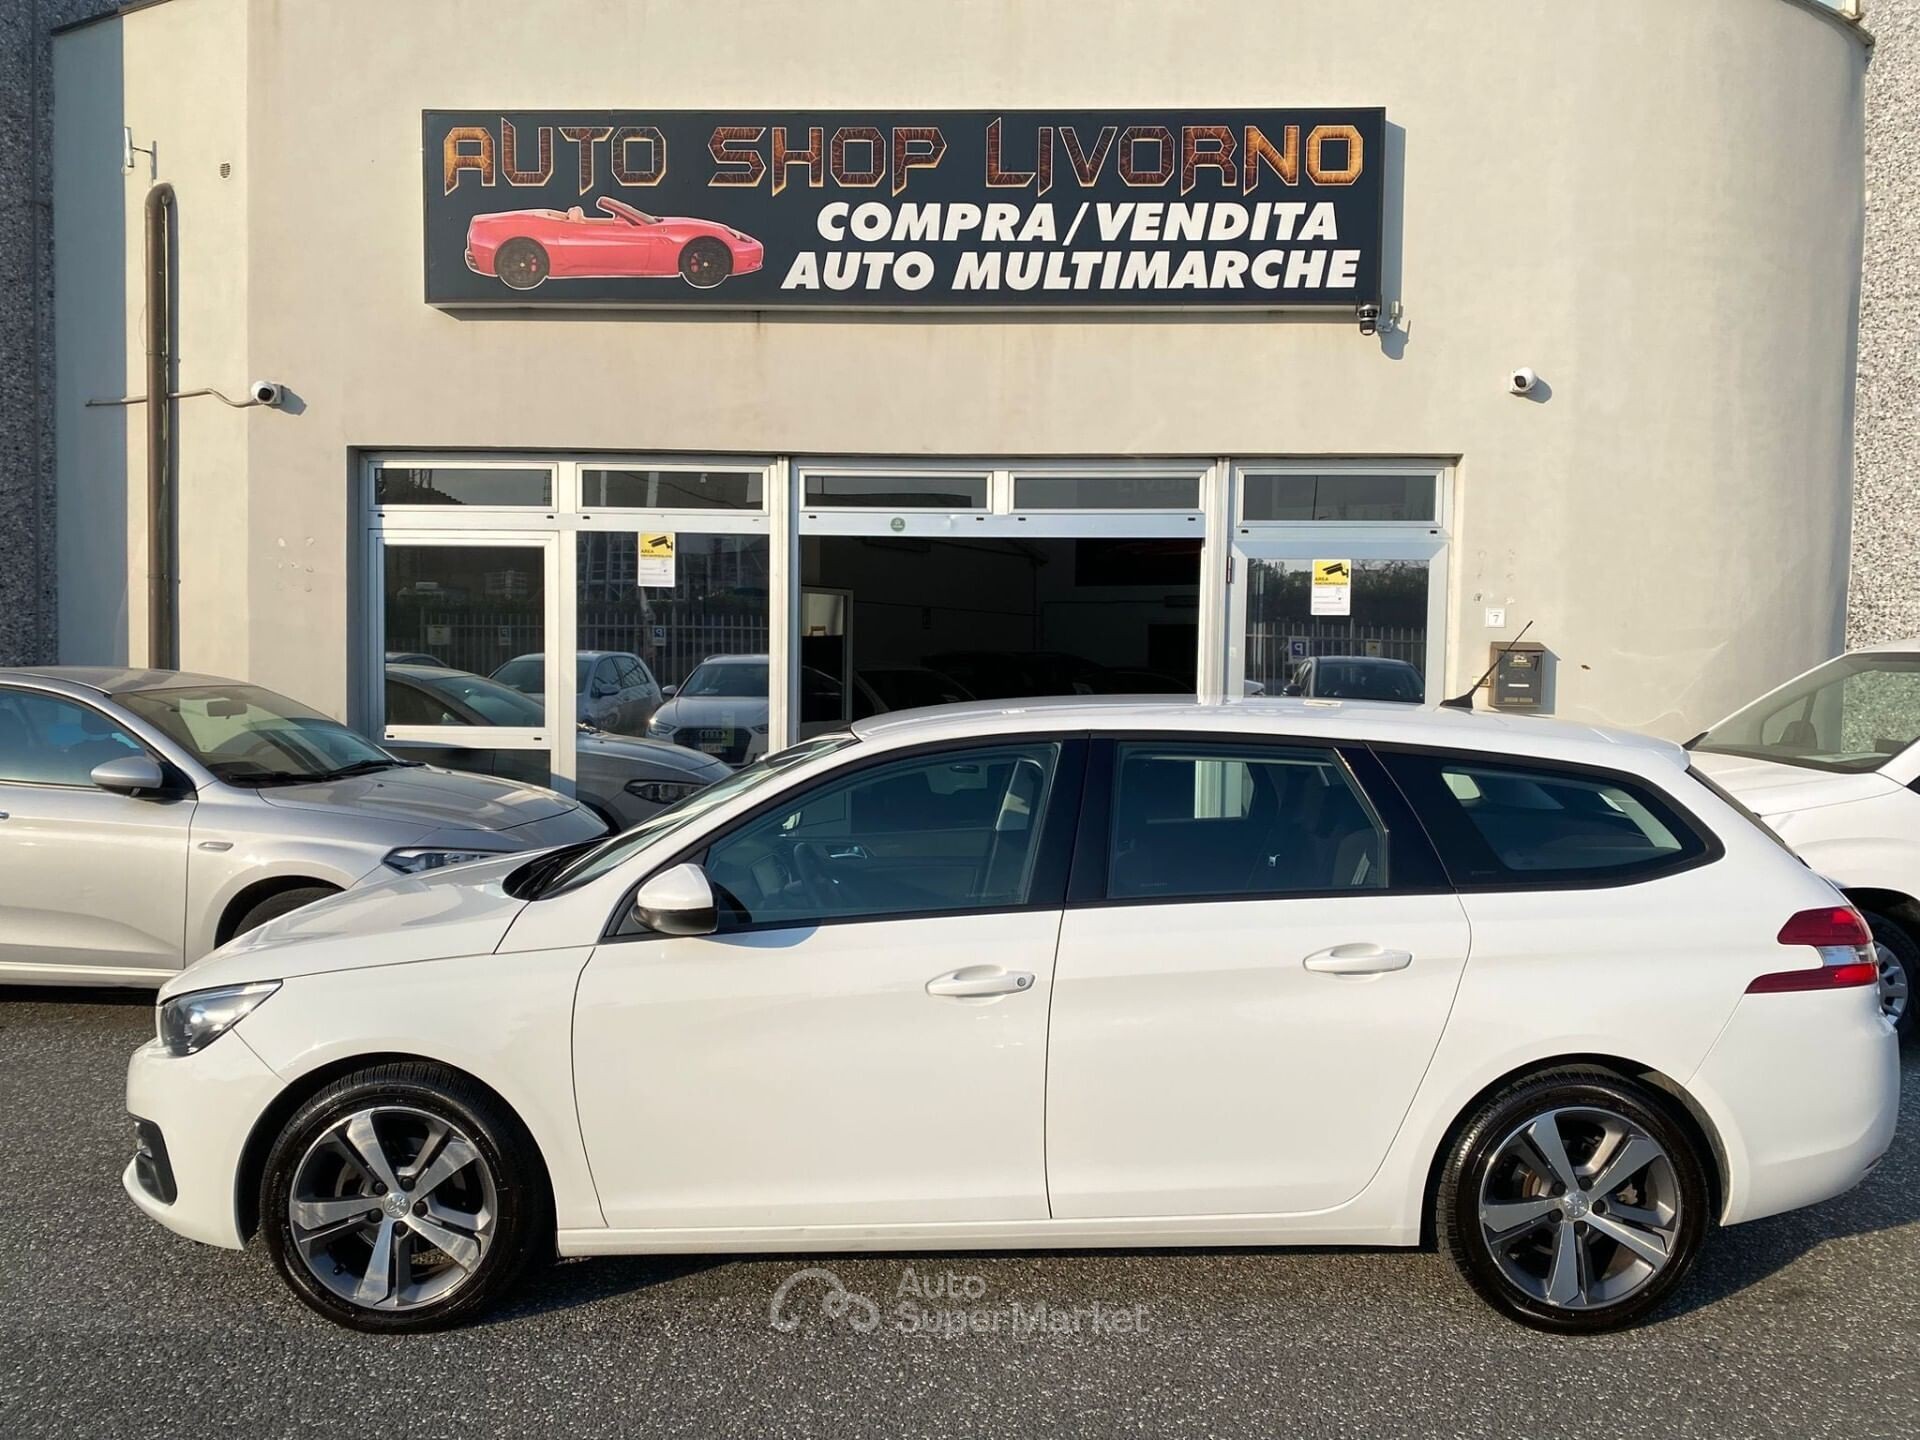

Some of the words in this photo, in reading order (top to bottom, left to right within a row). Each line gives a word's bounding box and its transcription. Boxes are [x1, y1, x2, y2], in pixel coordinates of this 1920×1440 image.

[443, 117, 667, 196] AUTO
[708, 126, 947, 197] SHOP
[986, 117, 1364, 197] LIVORNO
[816, 201, 1338, 246] COMPRA/VENDITA
[780, 251, 934, 291] AUTO
[951, 249, 1361, 291] MULTIMARCHE
[1493, 614, 1499, 623] 7
